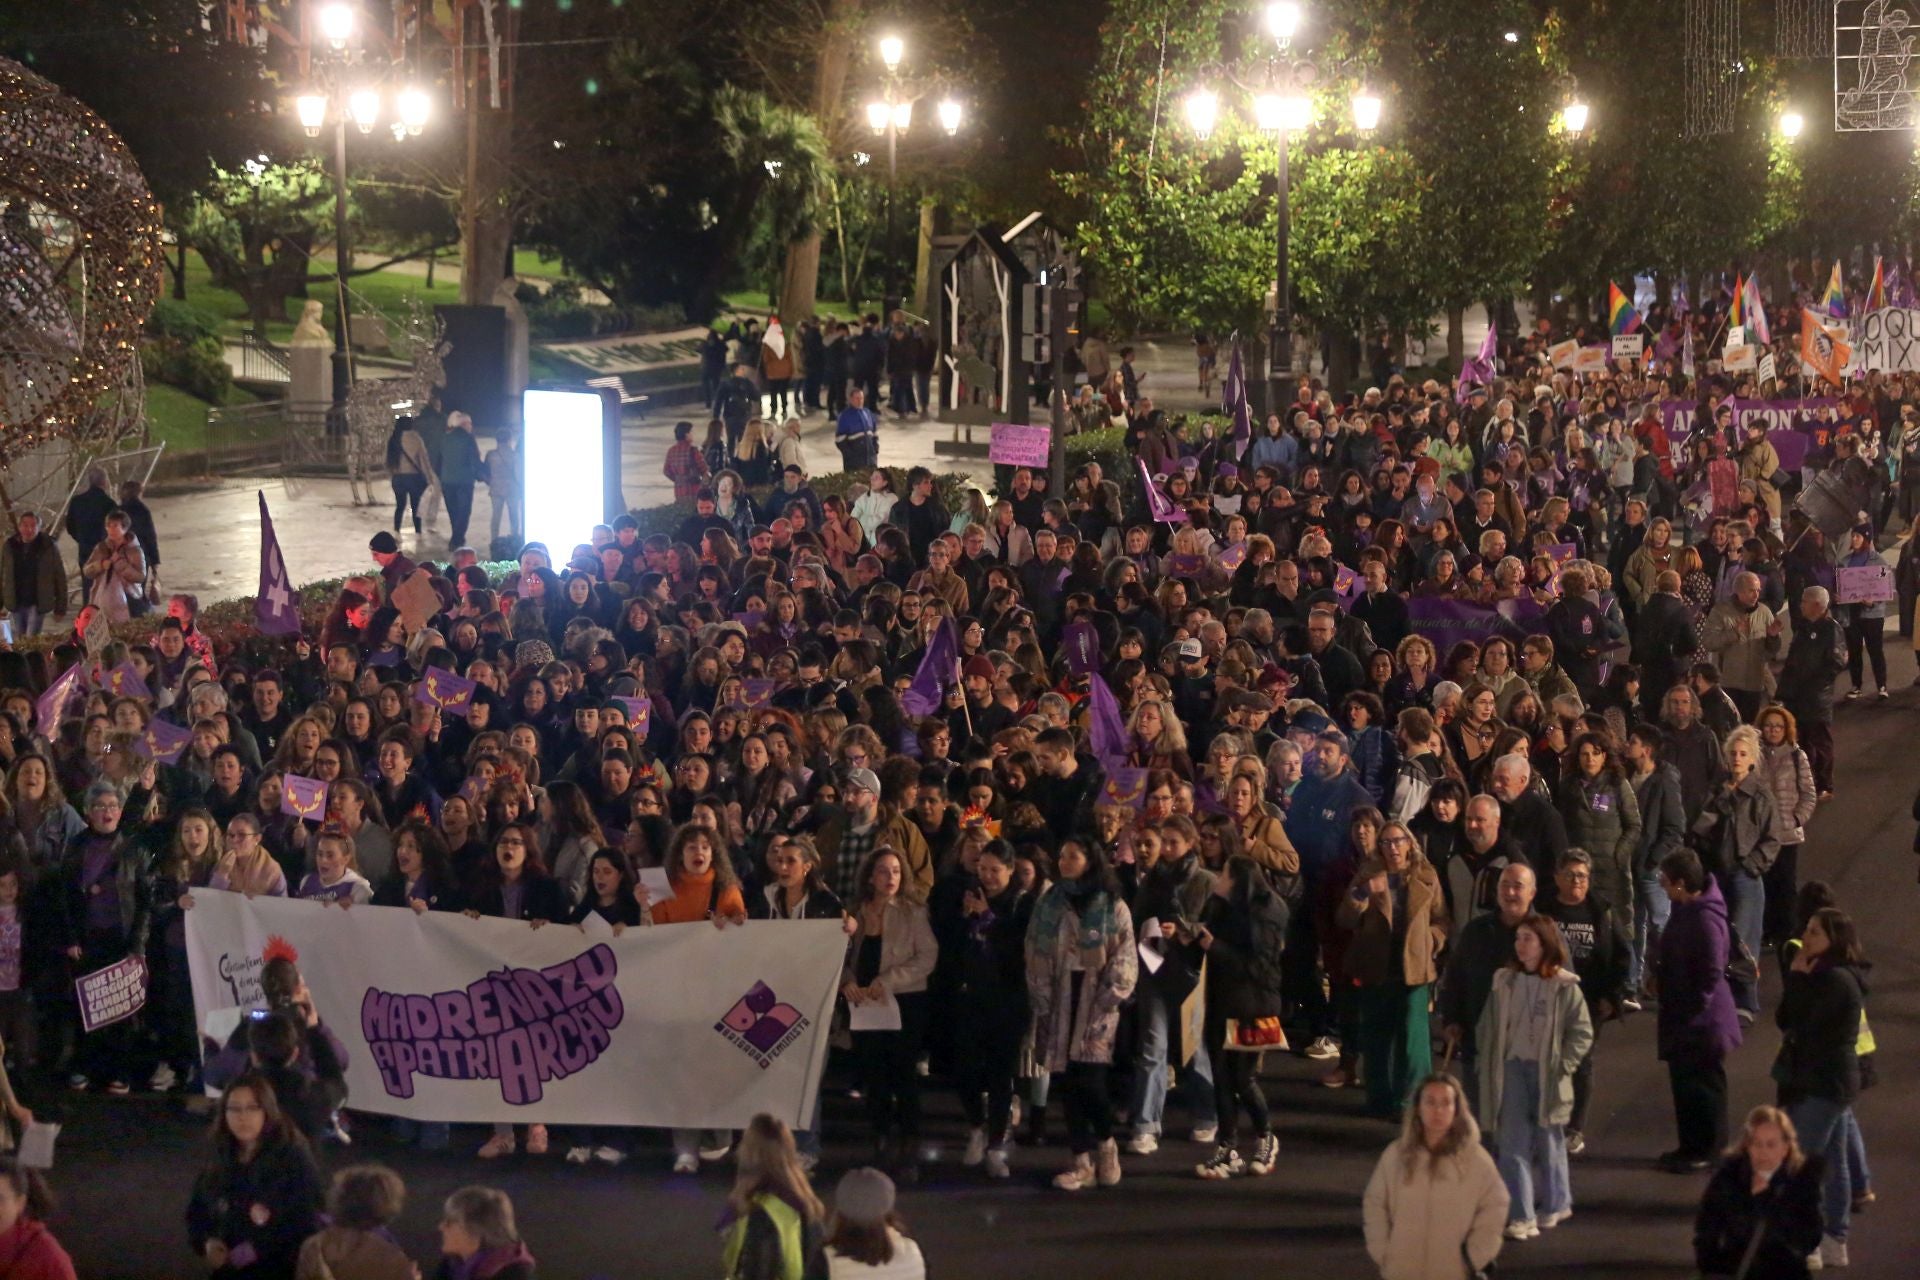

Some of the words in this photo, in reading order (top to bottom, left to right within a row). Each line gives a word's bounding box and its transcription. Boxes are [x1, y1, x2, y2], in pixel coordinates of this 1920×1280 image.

[1562, 929, 1595, 944] NISTA
[84, 973, 108, 992] QUE
[107, 967, 123, 983] LA
[361, 942, 618, 1044] MADREÑAZU
[88, 987, 131, 1013] CAMBIE
[130, 979, 142, 996] DE
[90, 1000, 131, 1025] BANDO
[767, 1017, 811, 1062] FEMINISTA
